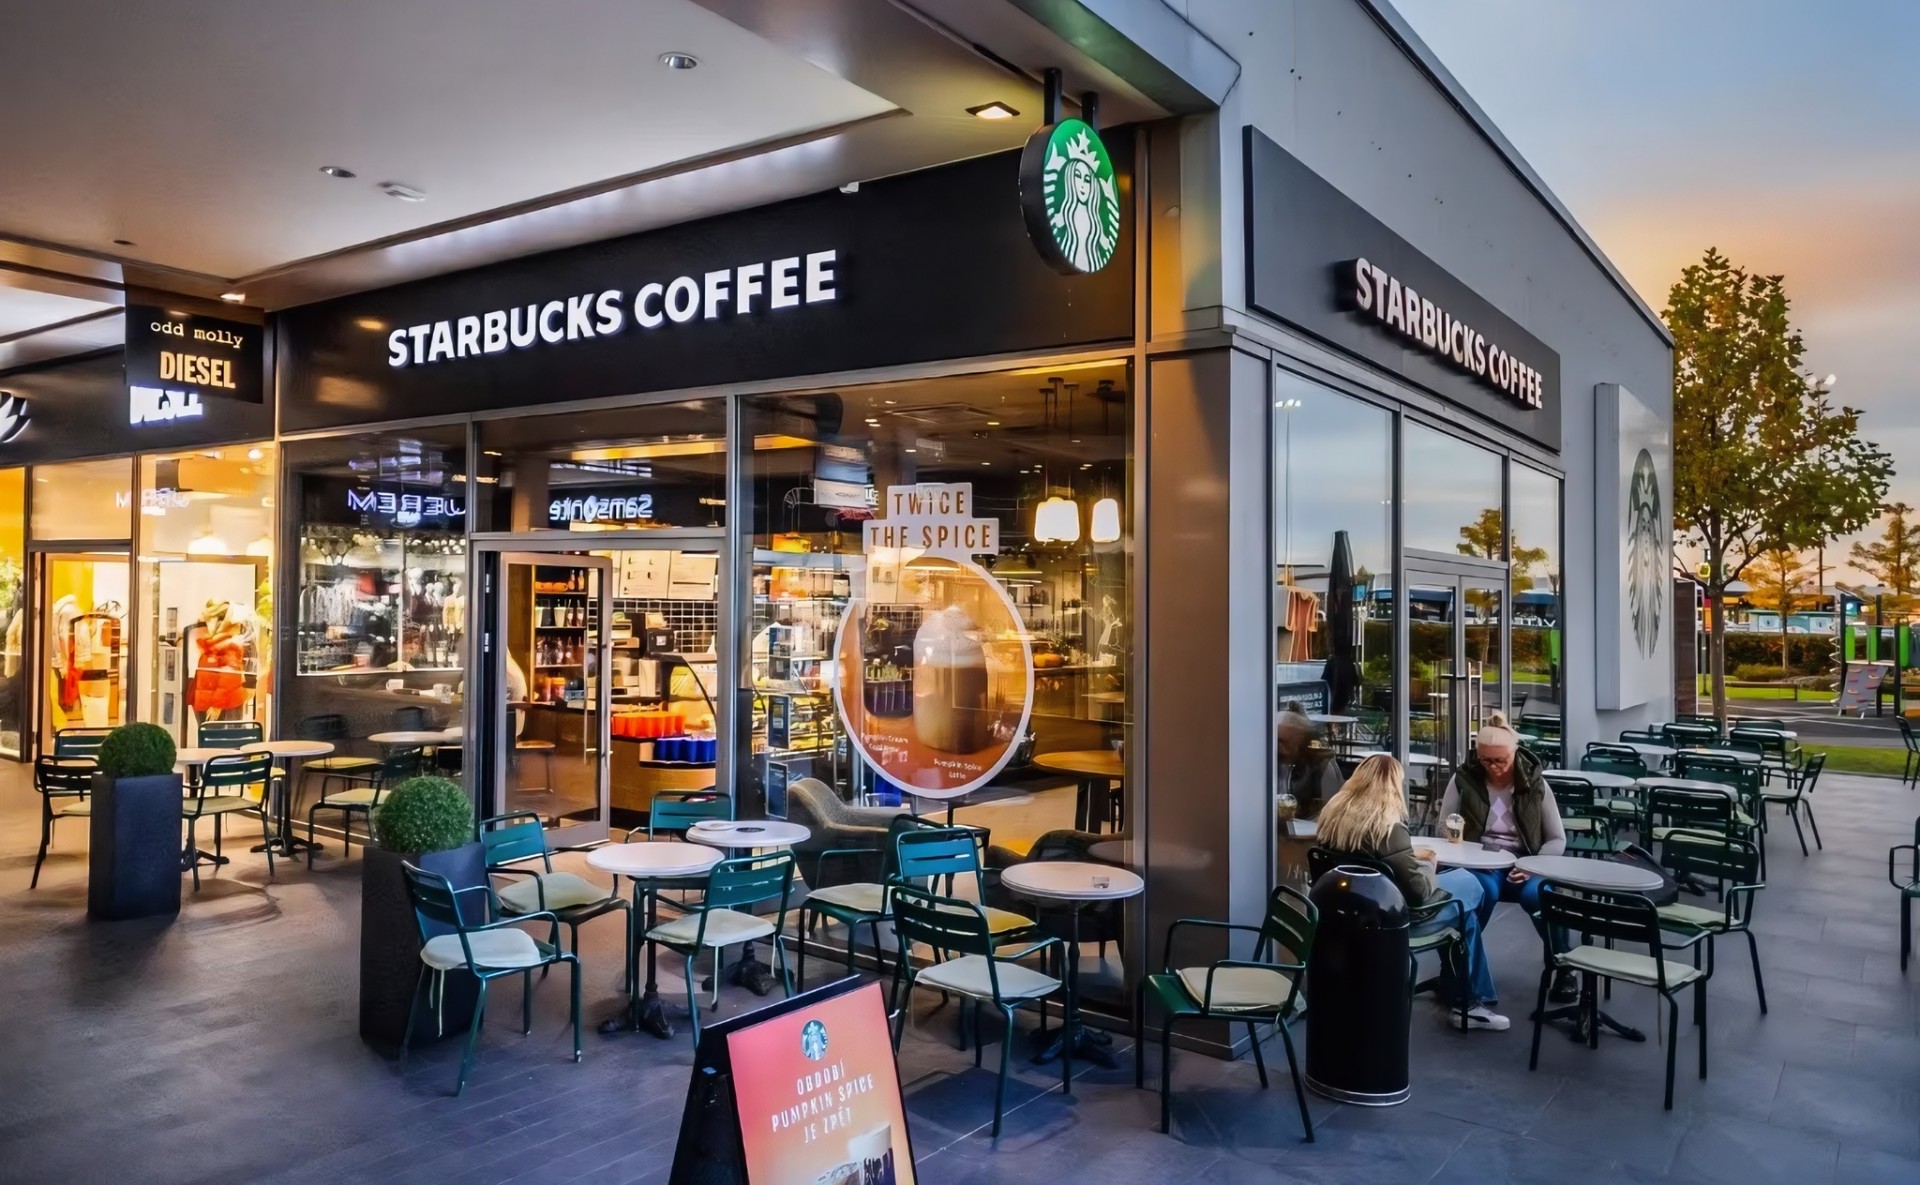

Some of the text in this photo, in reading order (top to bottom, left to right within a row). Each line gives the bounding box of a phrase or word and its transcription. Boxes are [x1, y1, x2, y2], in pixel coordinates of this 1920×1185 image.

[388, 249, 837, 368] STARBUCKS COFFEE
[150, 320, 244, 349] odd molly
[1356, 257, 1543, 409] STARBUCKS COFFEE
[160, 351, 236, 389] DIESEL
[894, 491, 964, 515] TWICE
[870, 524, 991, 549] THE SPICE
[771, 1073, 874, 1132] PUMPKIN SPICE
[804, 1123, 816, 1143] JE
